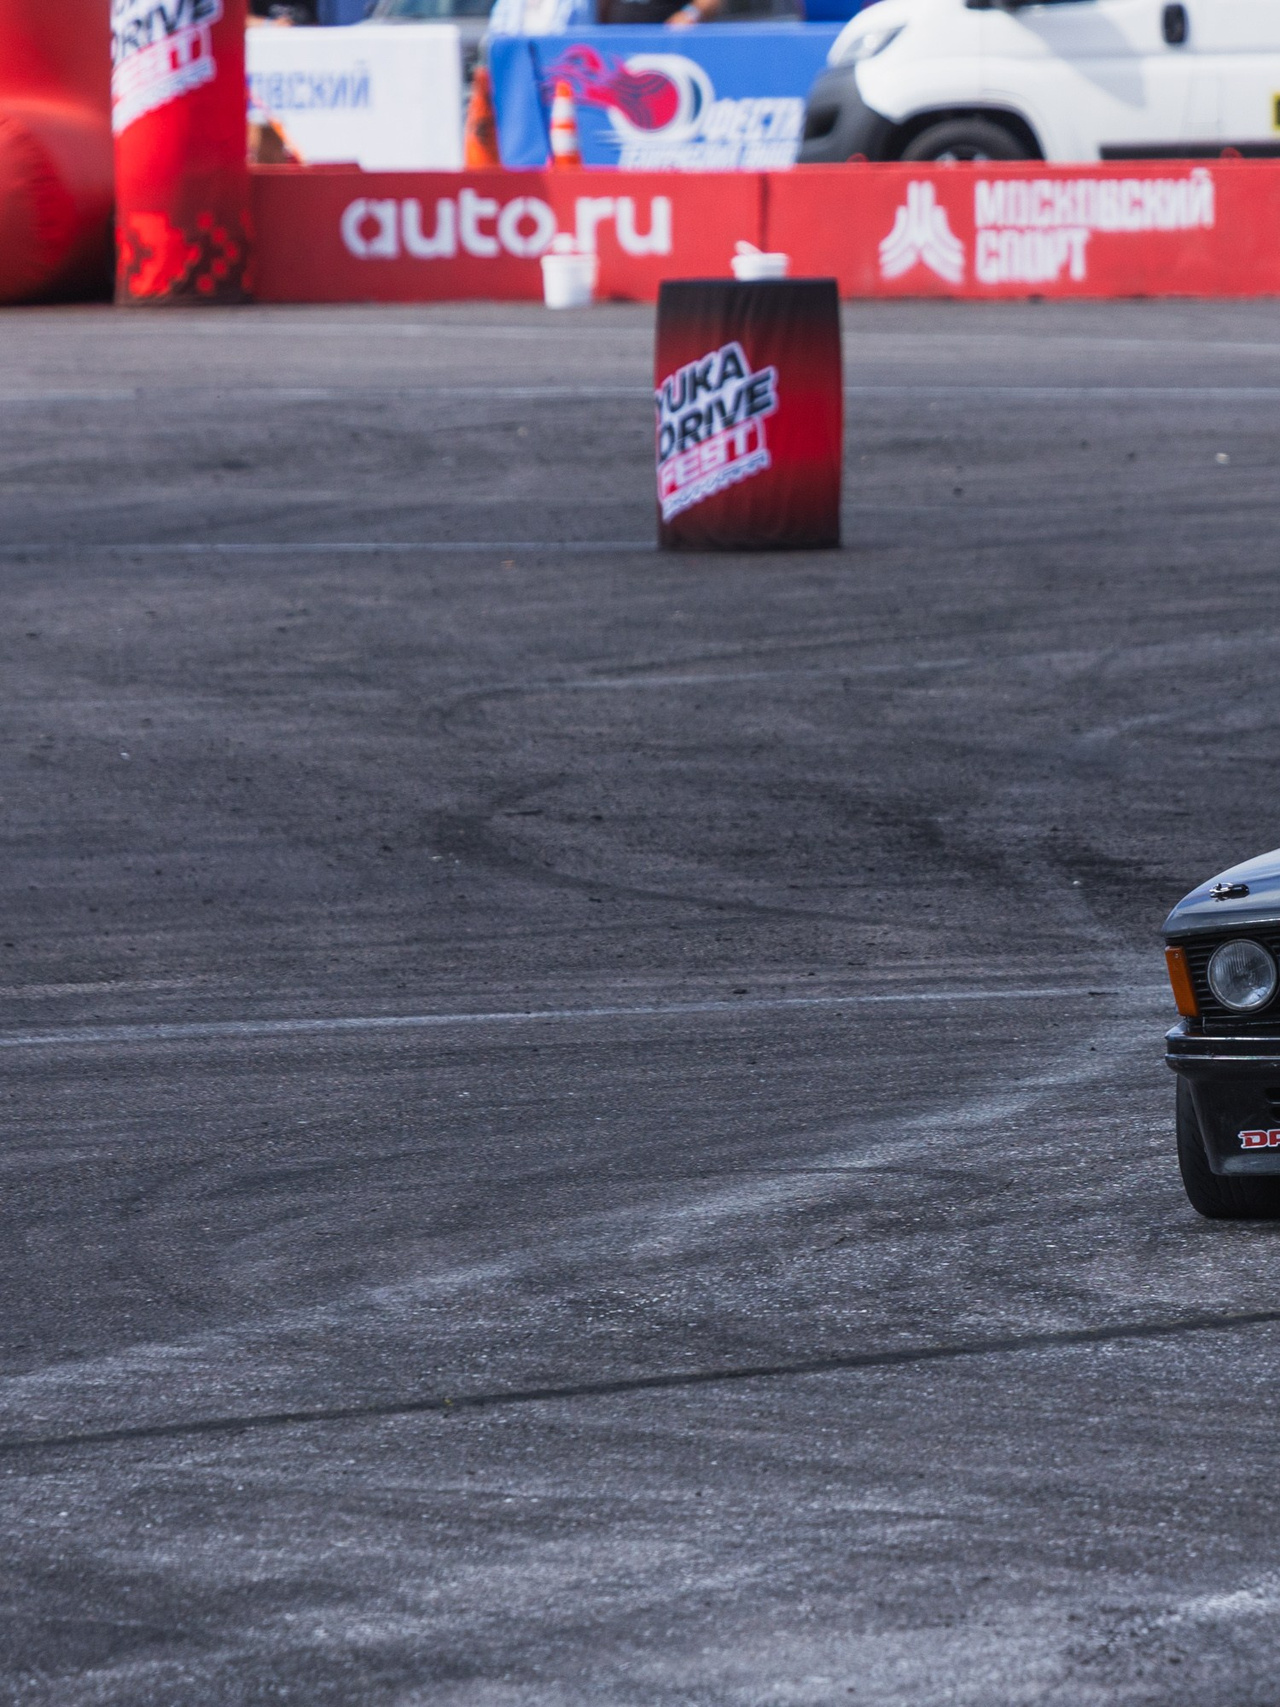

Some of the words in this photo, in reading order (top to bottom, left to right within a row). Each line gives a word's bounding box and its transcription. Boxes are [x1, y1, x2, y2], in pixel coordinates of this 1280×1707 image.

[341, 188, 672, 260] auto.ru
[974, 168, 1215, 232] МОСКОВСКИЙ
[974, 228, 1090, 284] СПОРТ
